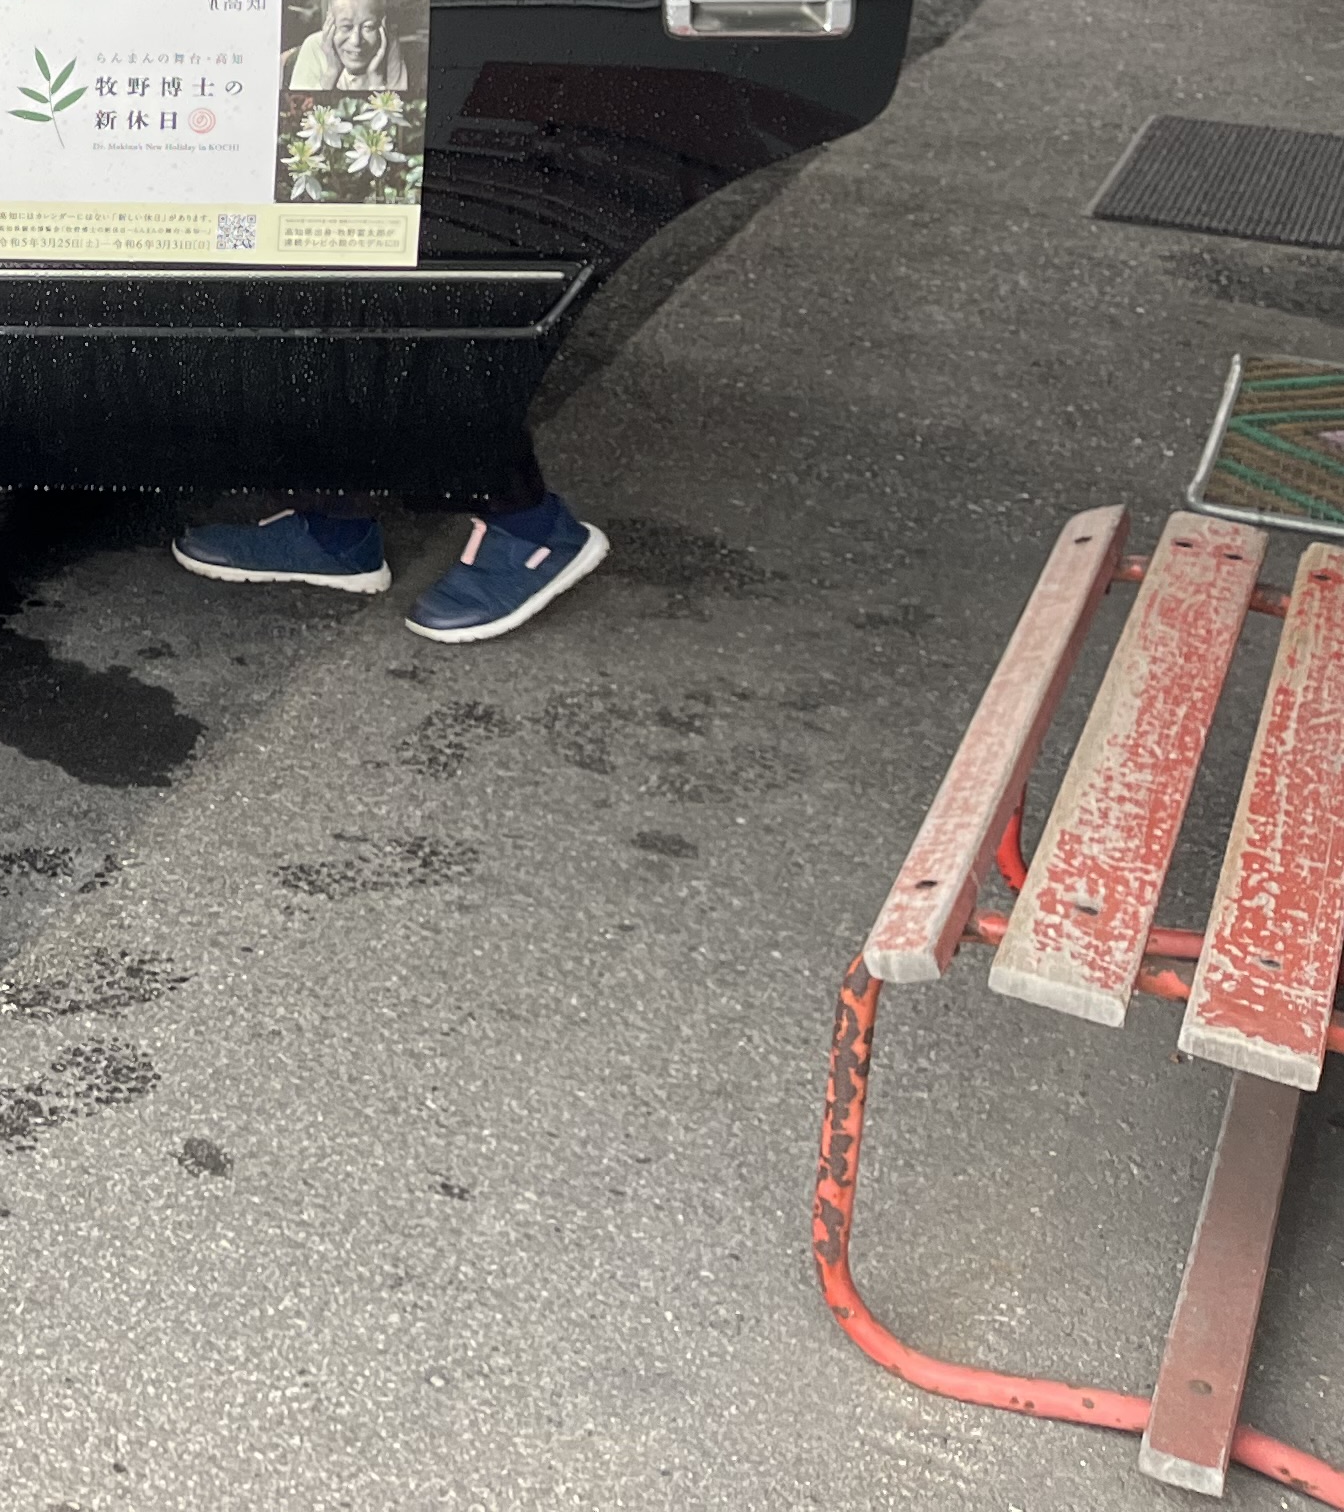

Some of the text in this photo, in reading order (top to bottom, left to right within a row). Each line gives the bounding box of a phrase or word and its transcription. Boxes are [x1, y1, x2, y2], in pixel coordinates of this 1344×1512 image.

[94, 76, 243, 97] 牧野博士の
[94, 109, 178, 130] 新休日
[145, 143, 163, 151] New
[208, 143, 241, 152] KOCHI
